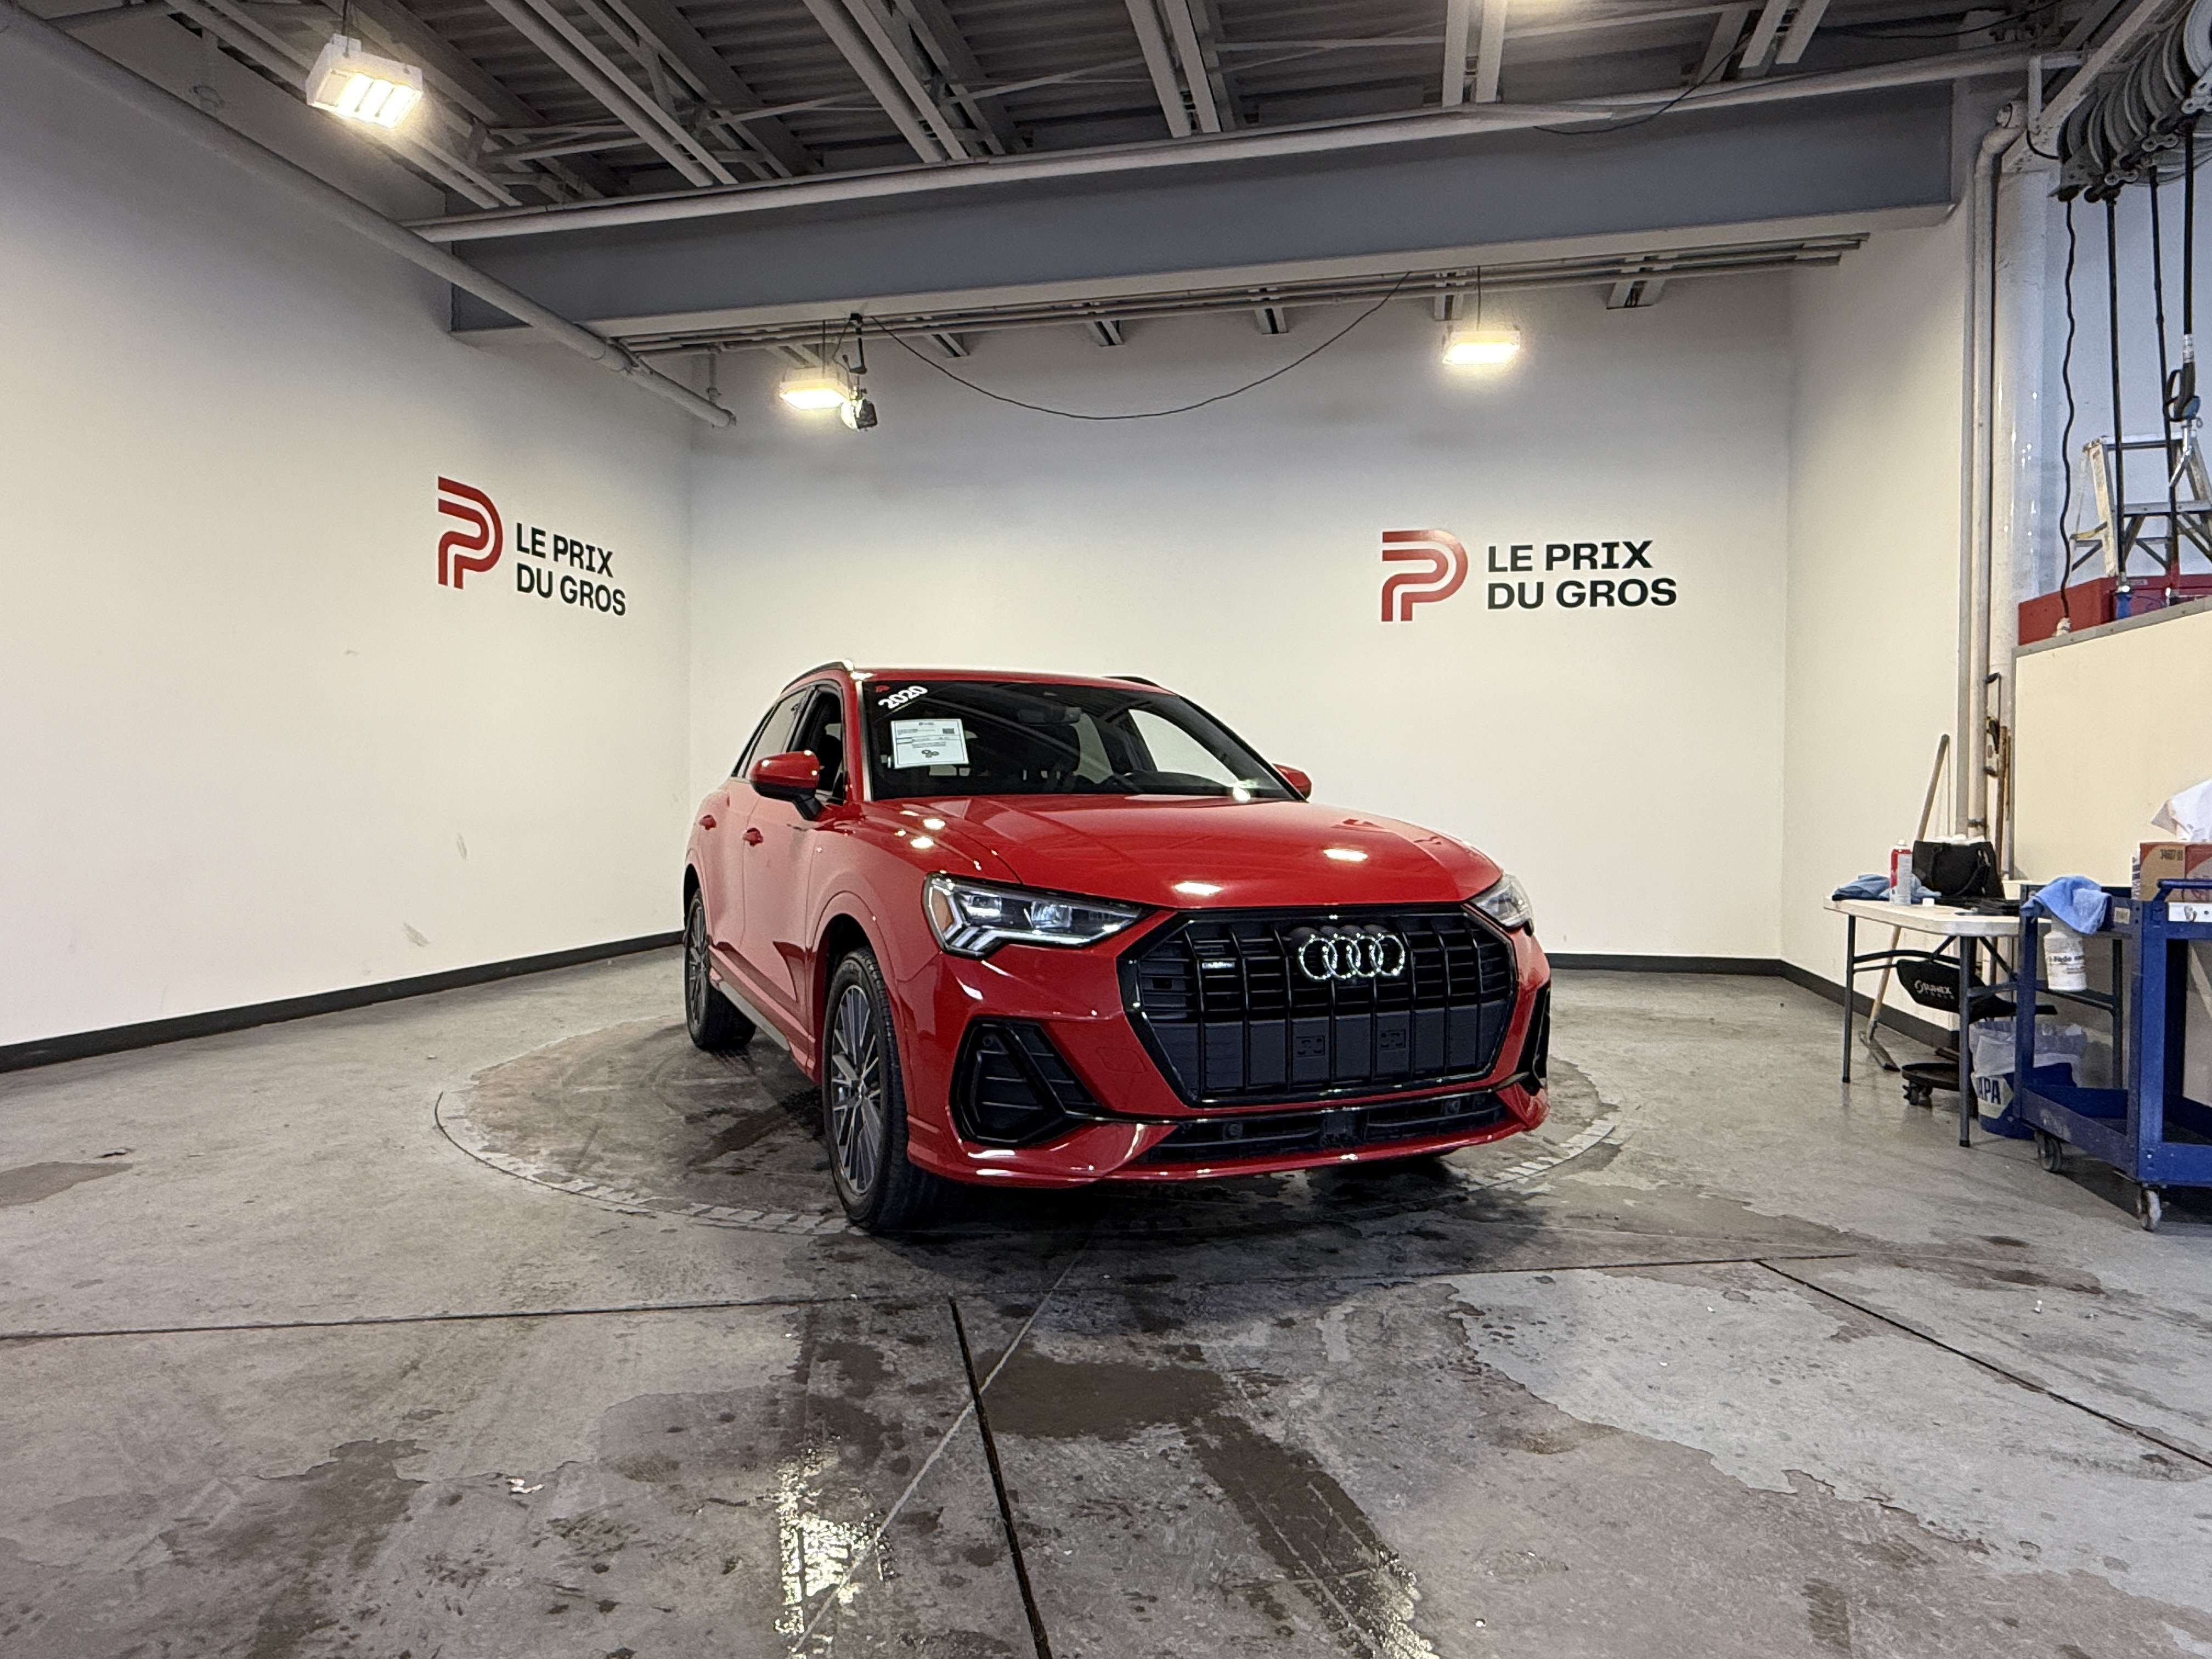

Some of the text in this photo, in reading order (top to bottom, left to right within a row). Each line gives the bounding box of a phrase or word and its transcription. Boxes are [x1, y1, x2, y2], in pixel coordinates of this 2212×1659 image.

[517, 522, 613, 578] LE PRIX
[1488, 540, 1653, 572] LE PRIX
[517, 563, 626, 616] DU GROS
[1487, 577, 1677, 610] DU GROS
[878, 686, 928, 709] 2020
[1976, 1077, 2001, 1105] APA
